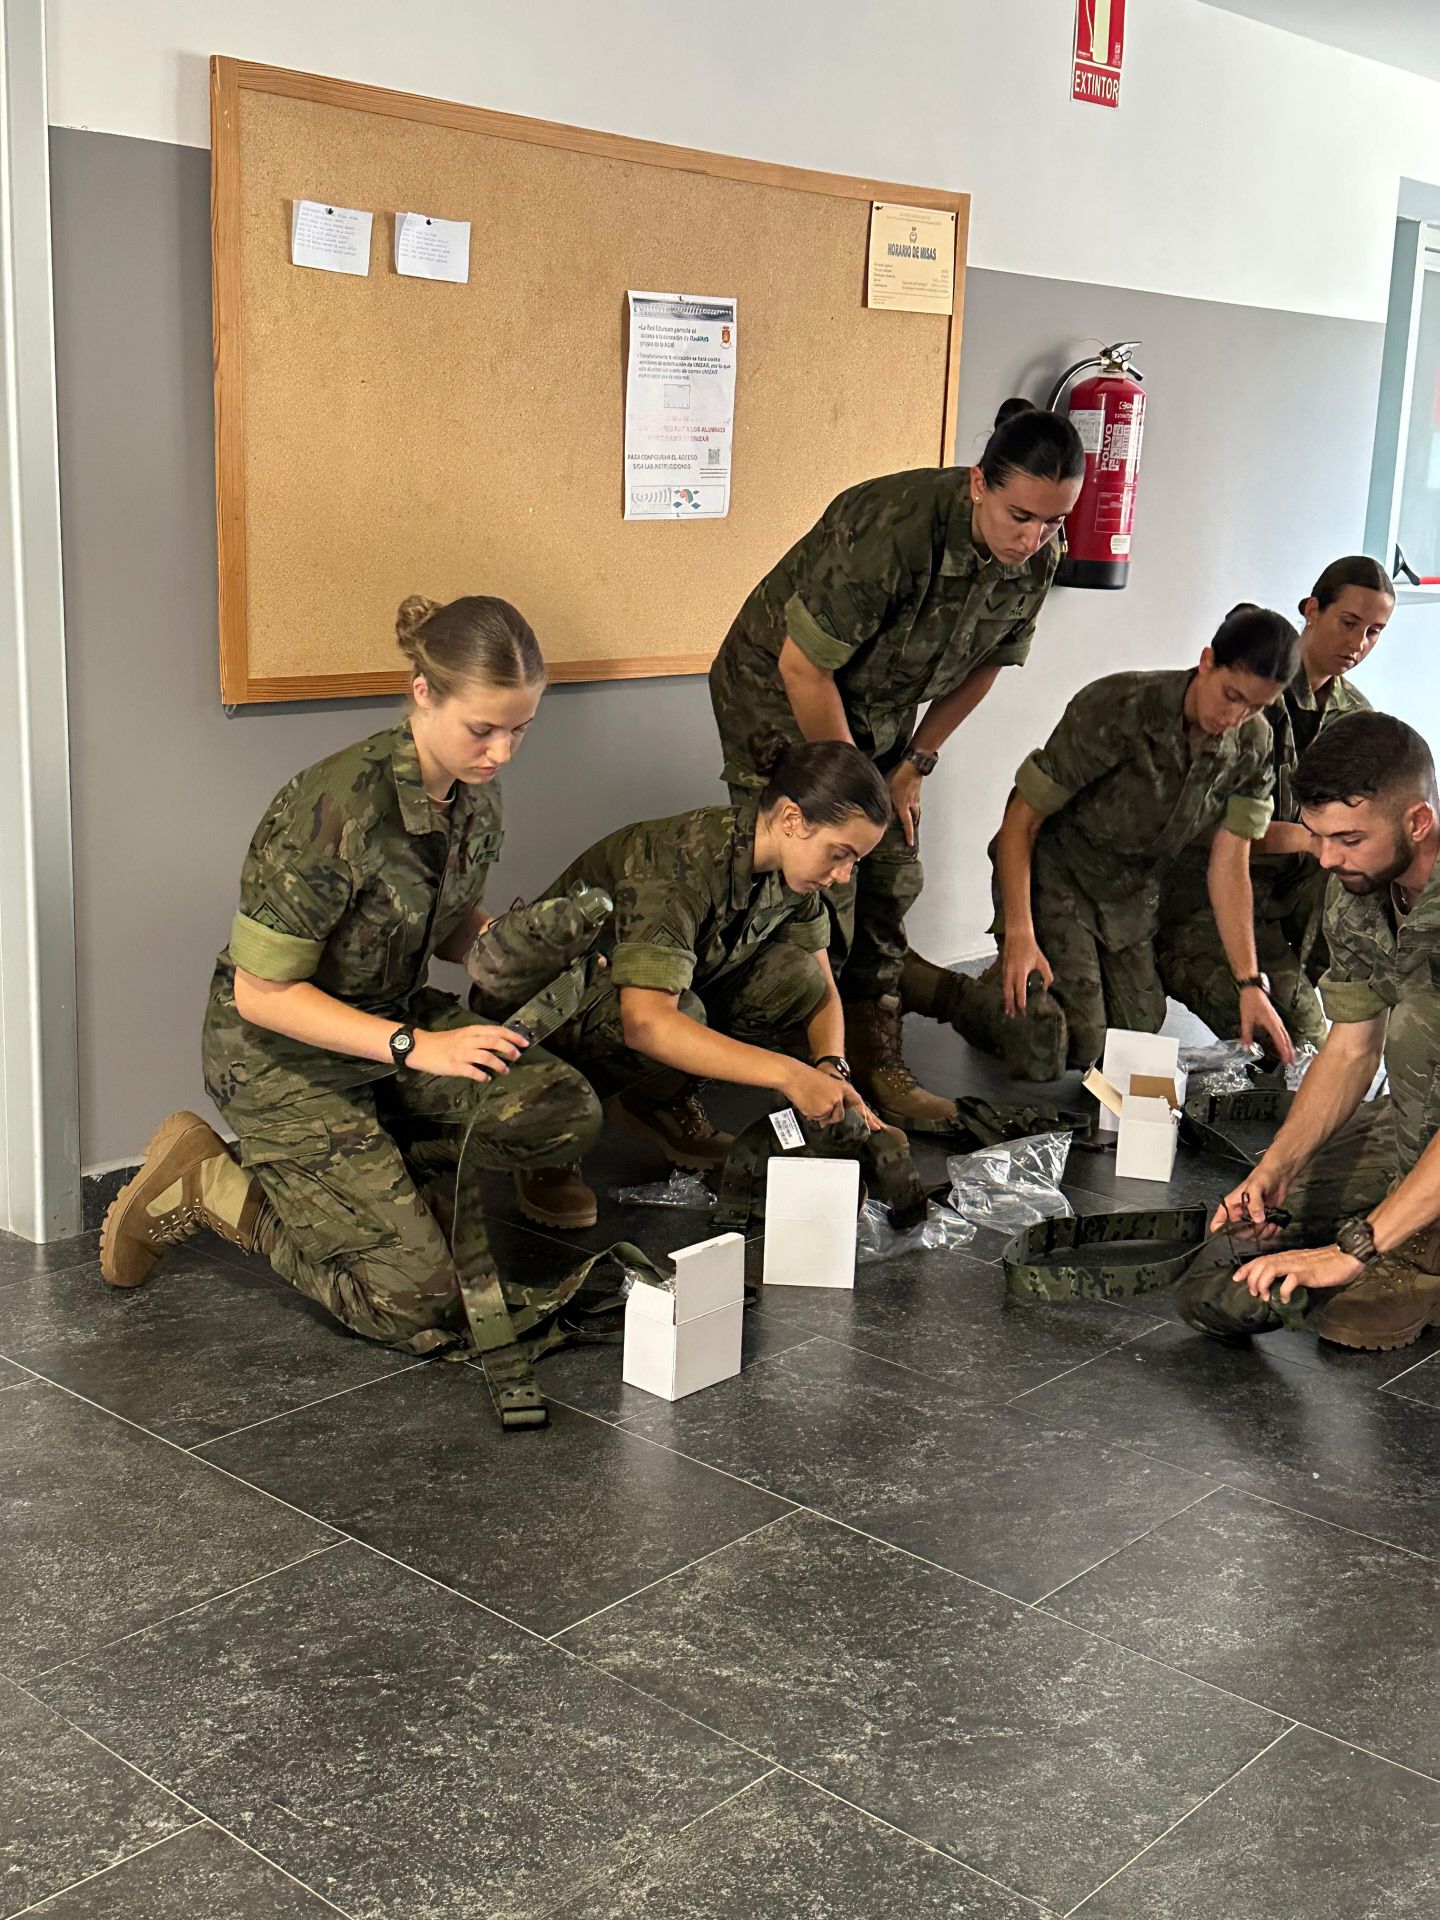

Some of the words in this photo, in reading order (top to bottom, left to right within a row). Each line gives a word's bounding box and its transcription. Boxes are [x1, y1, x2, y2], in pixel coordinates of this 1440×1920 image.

[1075, 70, 1119, 105] EXTINTOR
[887, 243, 911, 258] HORARIO
[912, 246, 919, 259] DE
[920, 247, 937, 260] MISAS
[1100, 424, 1112, 470] POLVO
